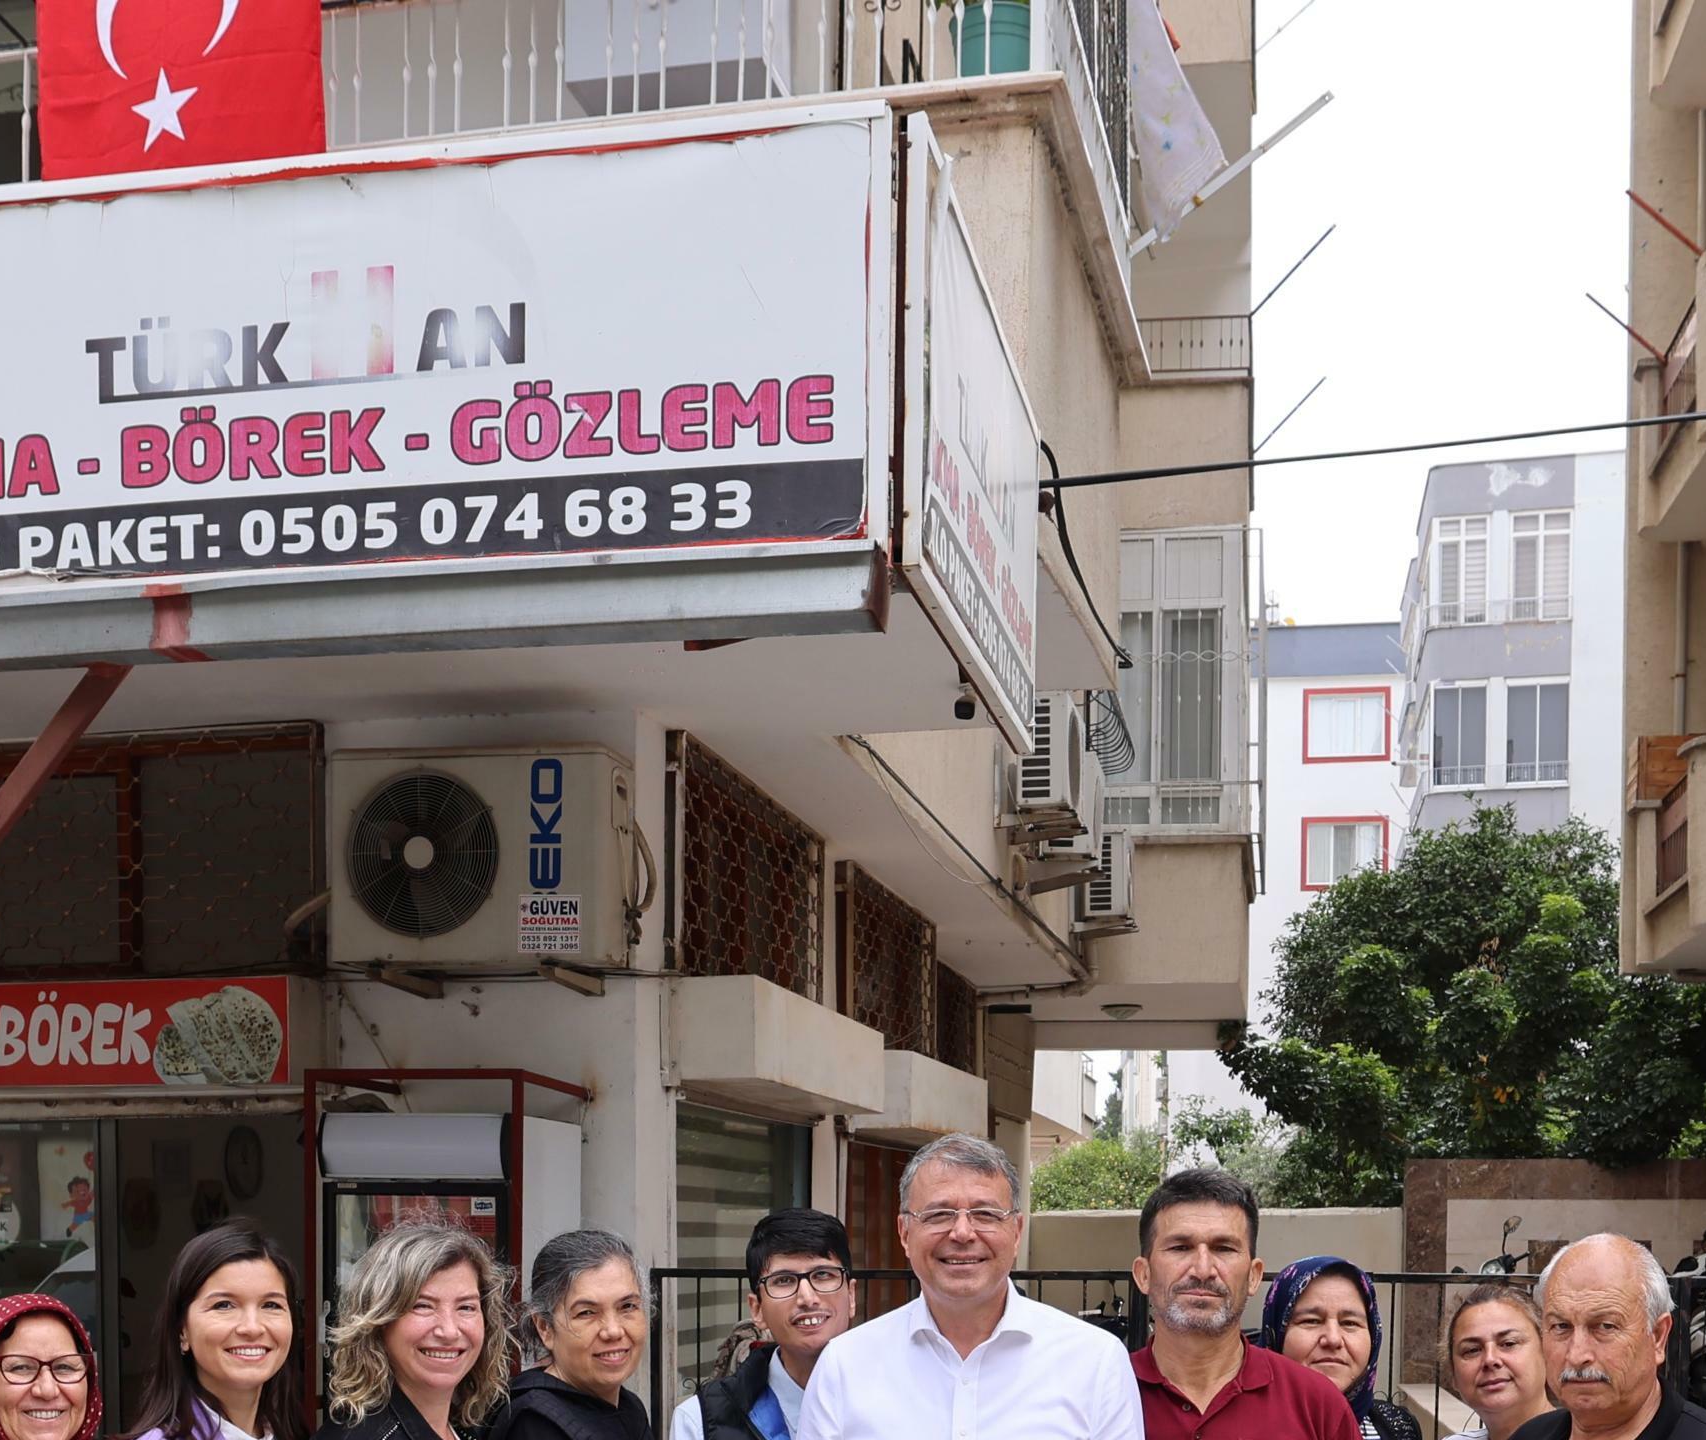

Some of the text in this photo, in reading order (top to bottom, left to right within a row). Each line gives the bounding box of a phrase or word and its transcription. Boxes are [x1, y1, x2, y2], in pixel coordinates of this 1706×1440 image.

[77, 457, 101, 475] -
[120, 405, 386, 489] BÖREK
[404, 433, 430, 451] -
[449, 374, 835, 466] GÖZLEME
[17, 512, 222, 571] PAKET:
[239, 500, 397, 557] 0505
[419, 492, 544, 545] 074
[564, 486, 647, 538] 68
[669, 479, 753, 531] 33
[530, 758, 563, 895] EKO
[522, 916, 578, 925] SOĞUTMA
[529, 897, 578, 915] GÜVEN
